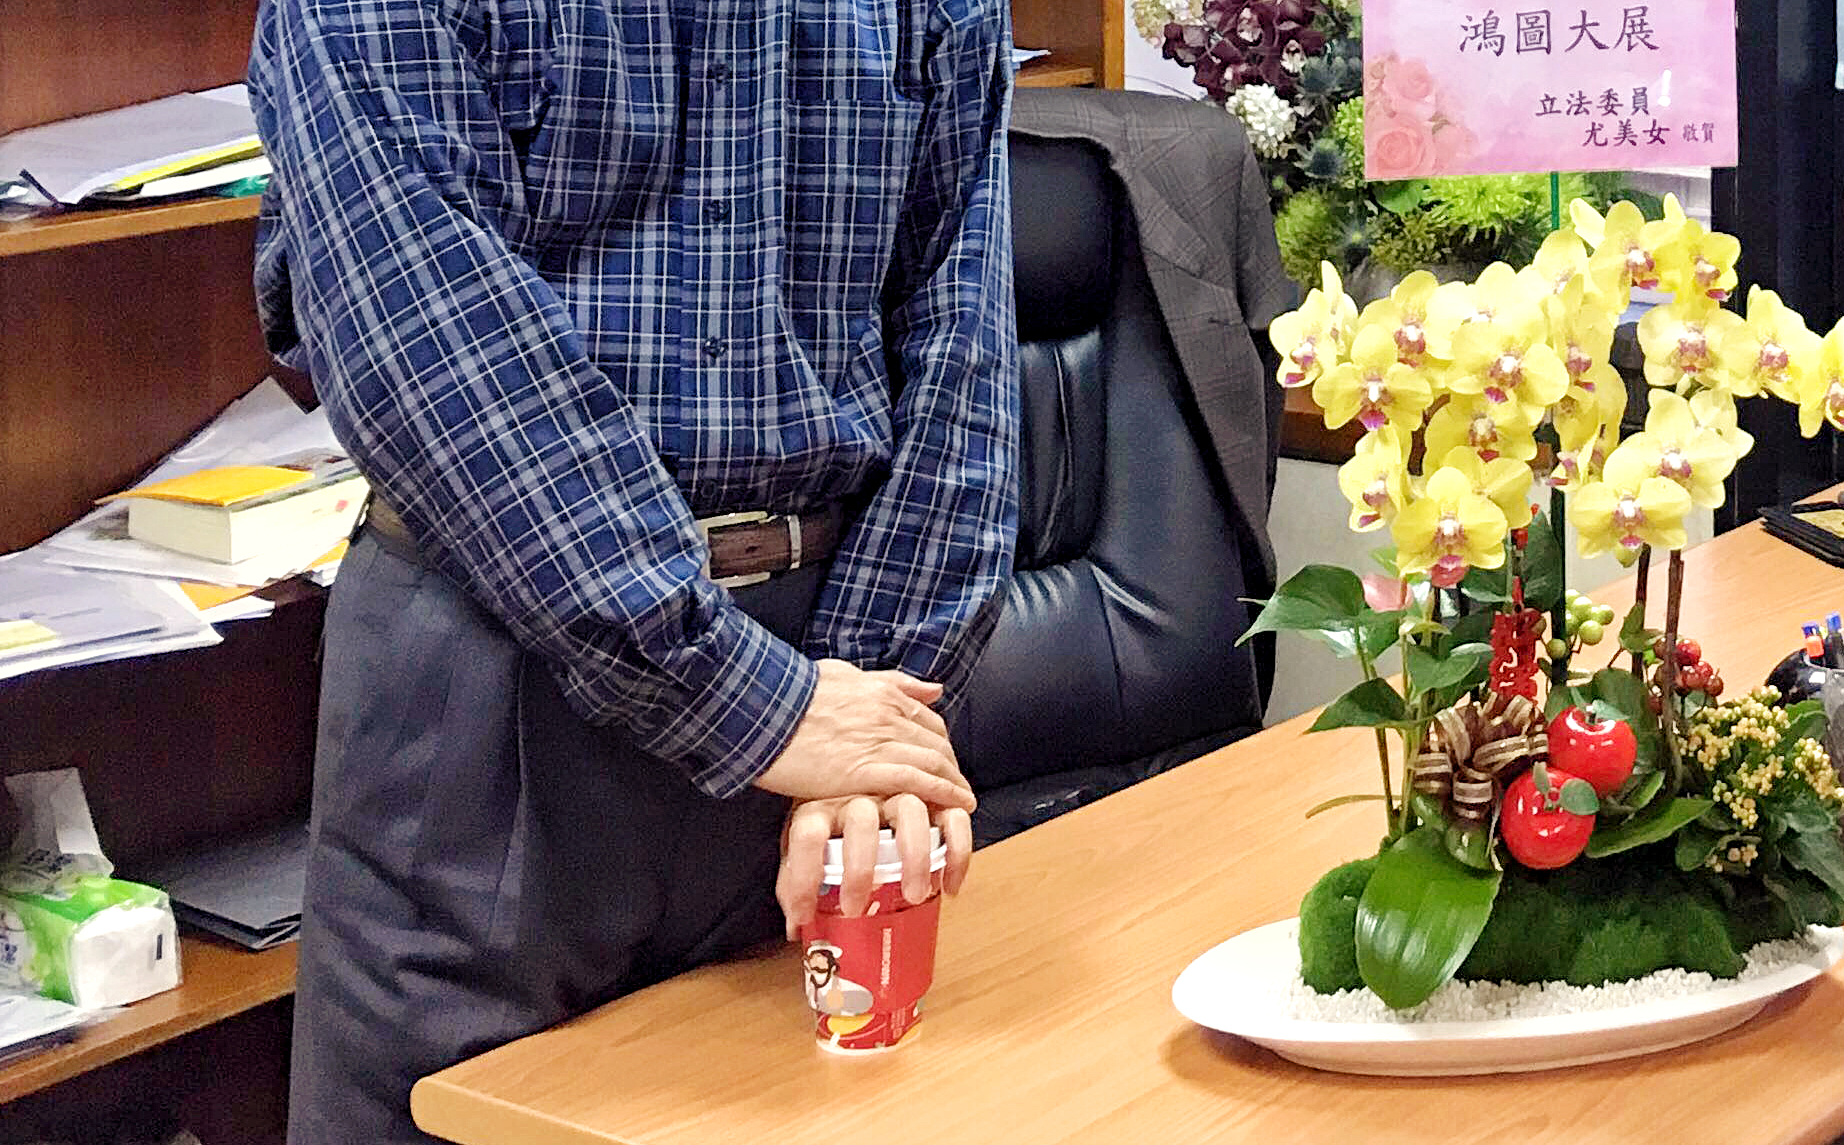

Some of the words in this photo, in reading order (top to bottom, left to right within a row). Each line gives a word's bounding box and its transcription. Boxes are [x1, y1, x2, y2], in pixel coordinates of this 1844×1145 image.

[1458, 5, 1660, 57] 鴻圖大展
[1534, 86, 1650, 117] 立法委員
[1582, 119, 1671, 147] 尤美女
[1682, 121, 1715, 144] 敬賀
